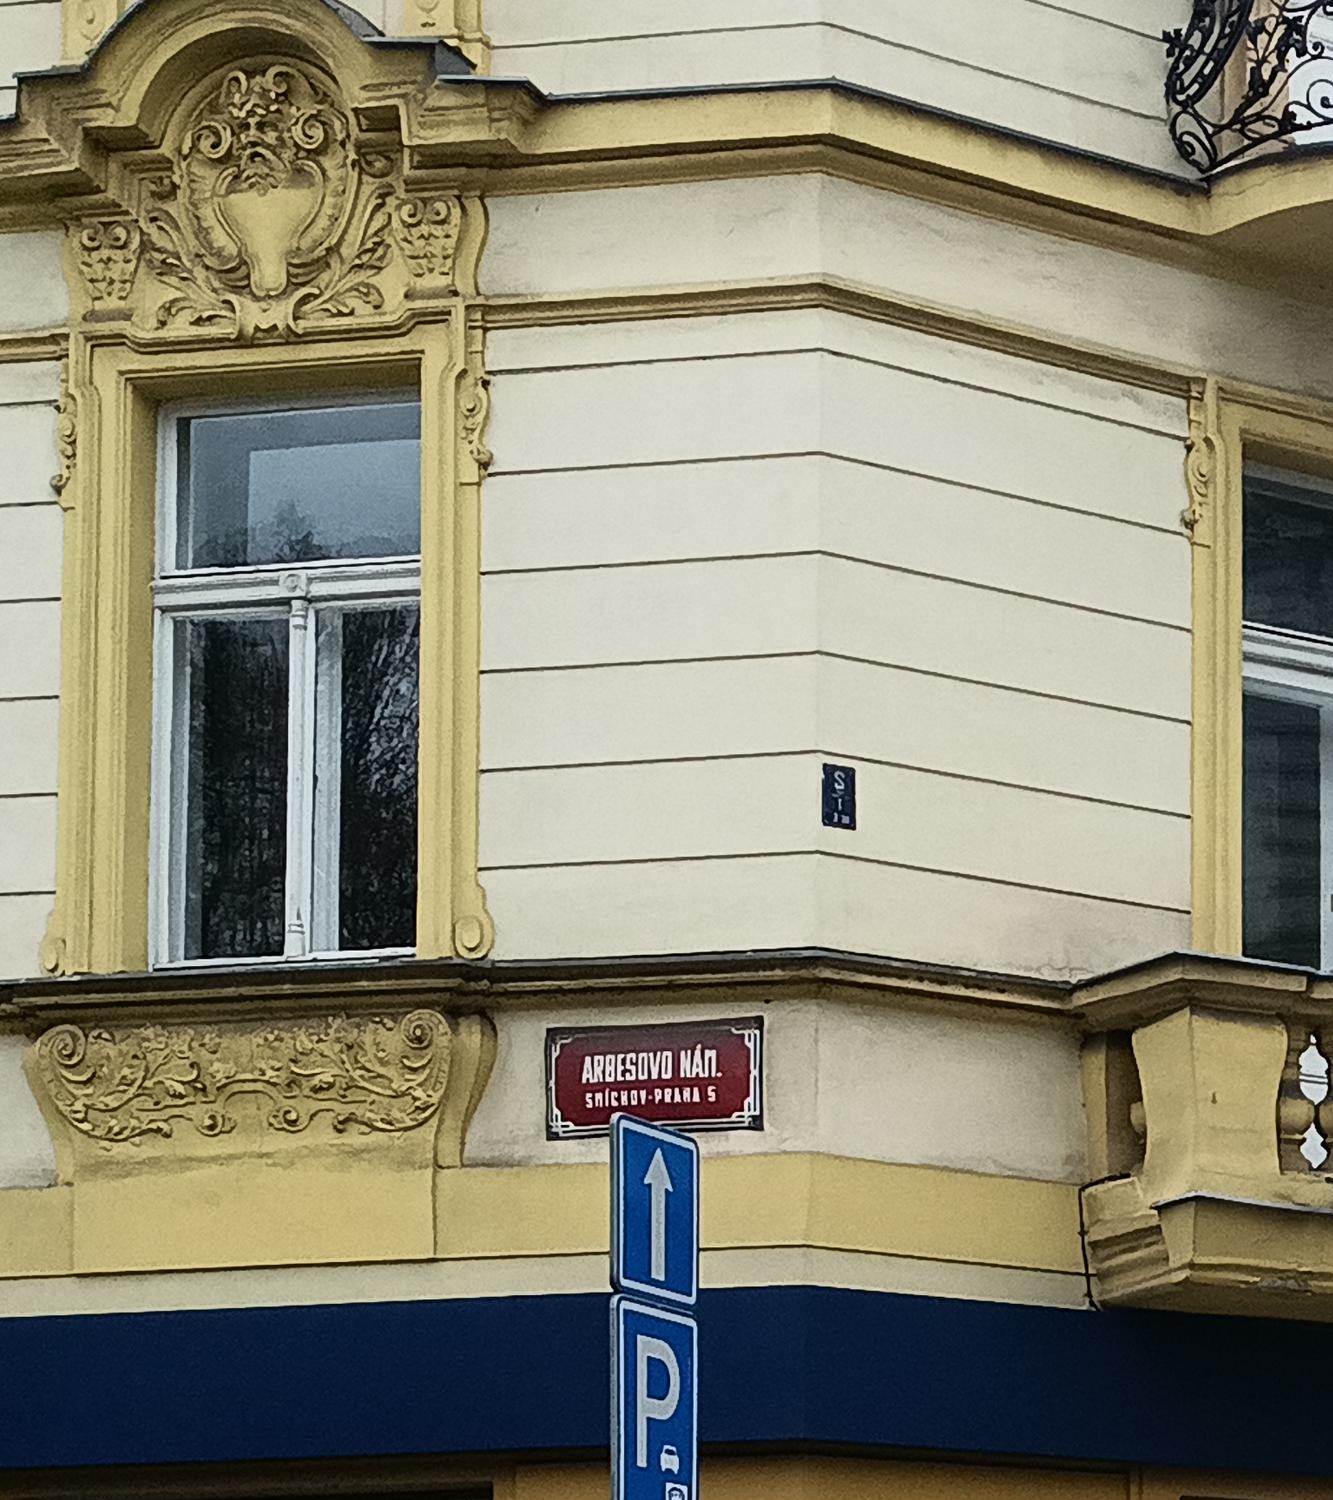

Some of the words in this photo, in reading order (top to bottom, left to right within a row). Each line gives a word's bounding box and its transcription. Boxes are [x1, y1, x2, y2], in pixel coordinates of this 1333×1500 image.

[581, 1051, 673, 1084] ARBESOVO
[680, 1043, 723, 1078] NÁM.
[637, 1334, 680, 1469] P
